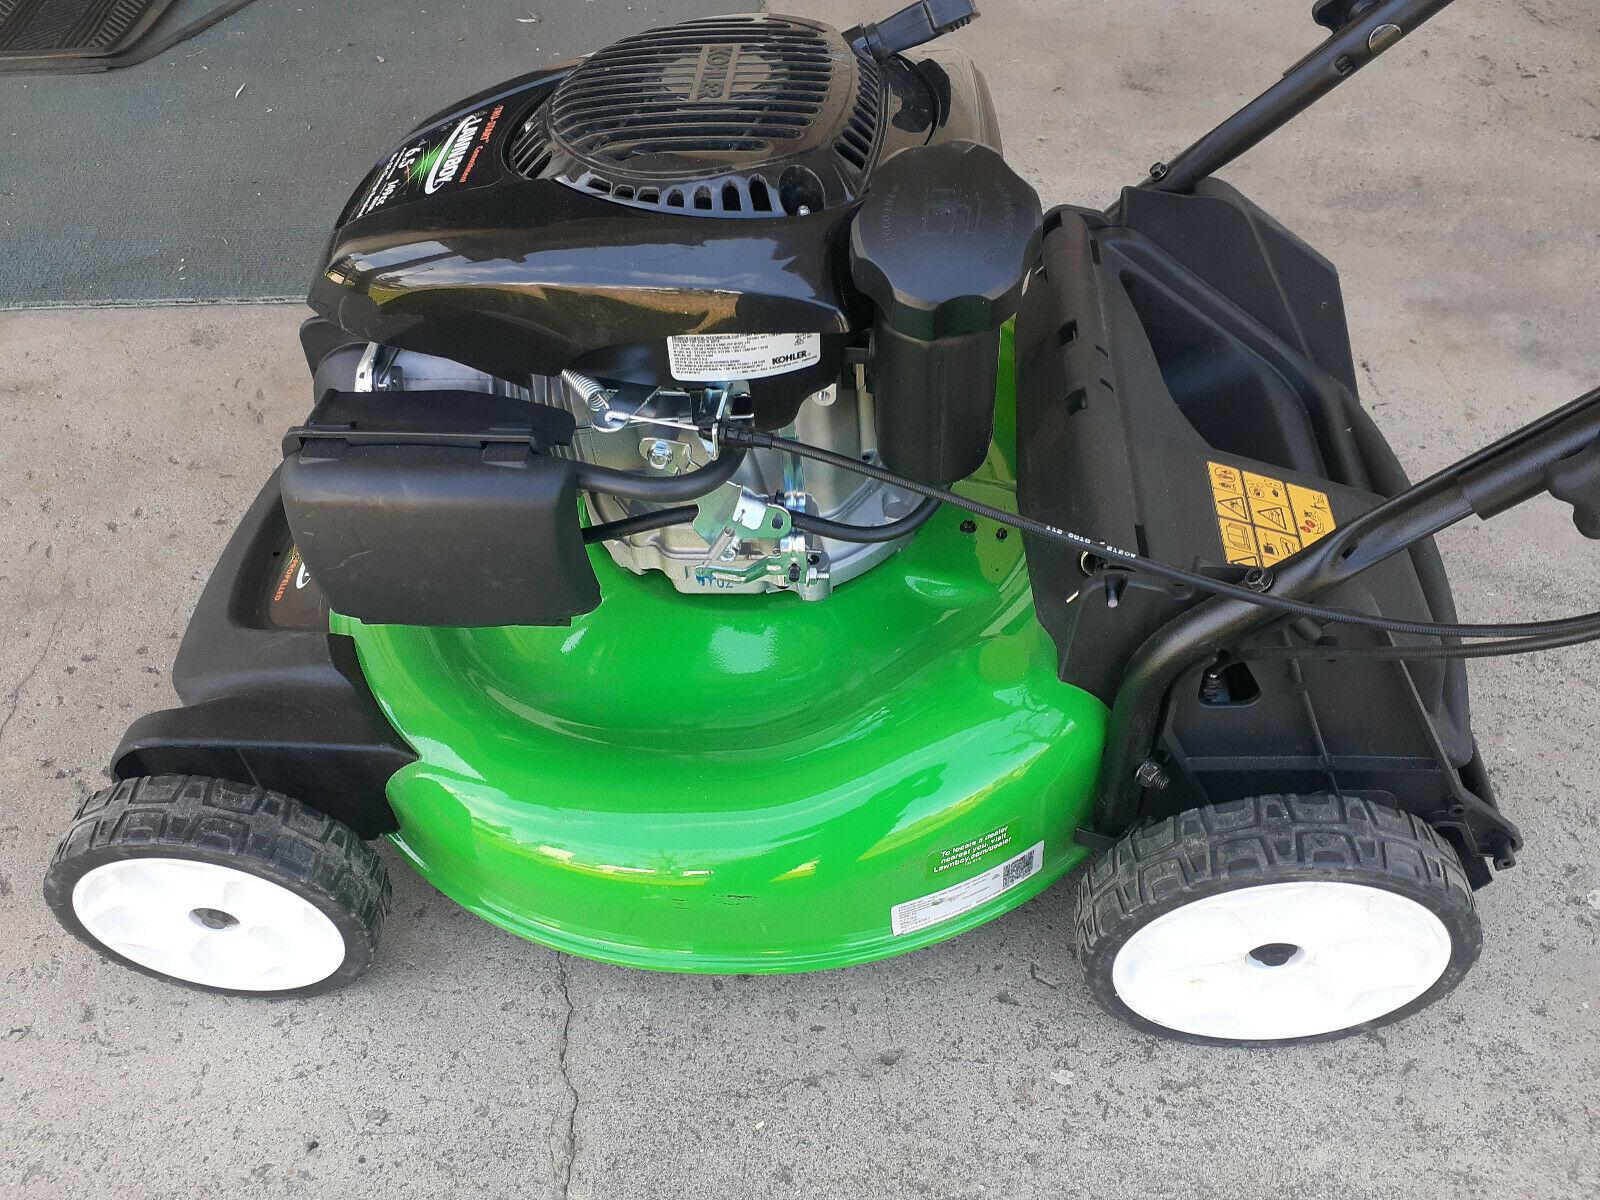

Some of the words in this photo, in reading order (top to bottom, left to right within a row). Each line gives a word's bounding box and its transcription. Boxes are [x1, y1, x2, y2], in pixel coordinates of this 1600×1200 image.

[697, 45, 734, 99] KOHLER
[771, 350, 807, 365] KOHLER
[984, 826, 1009, 841] dealer
